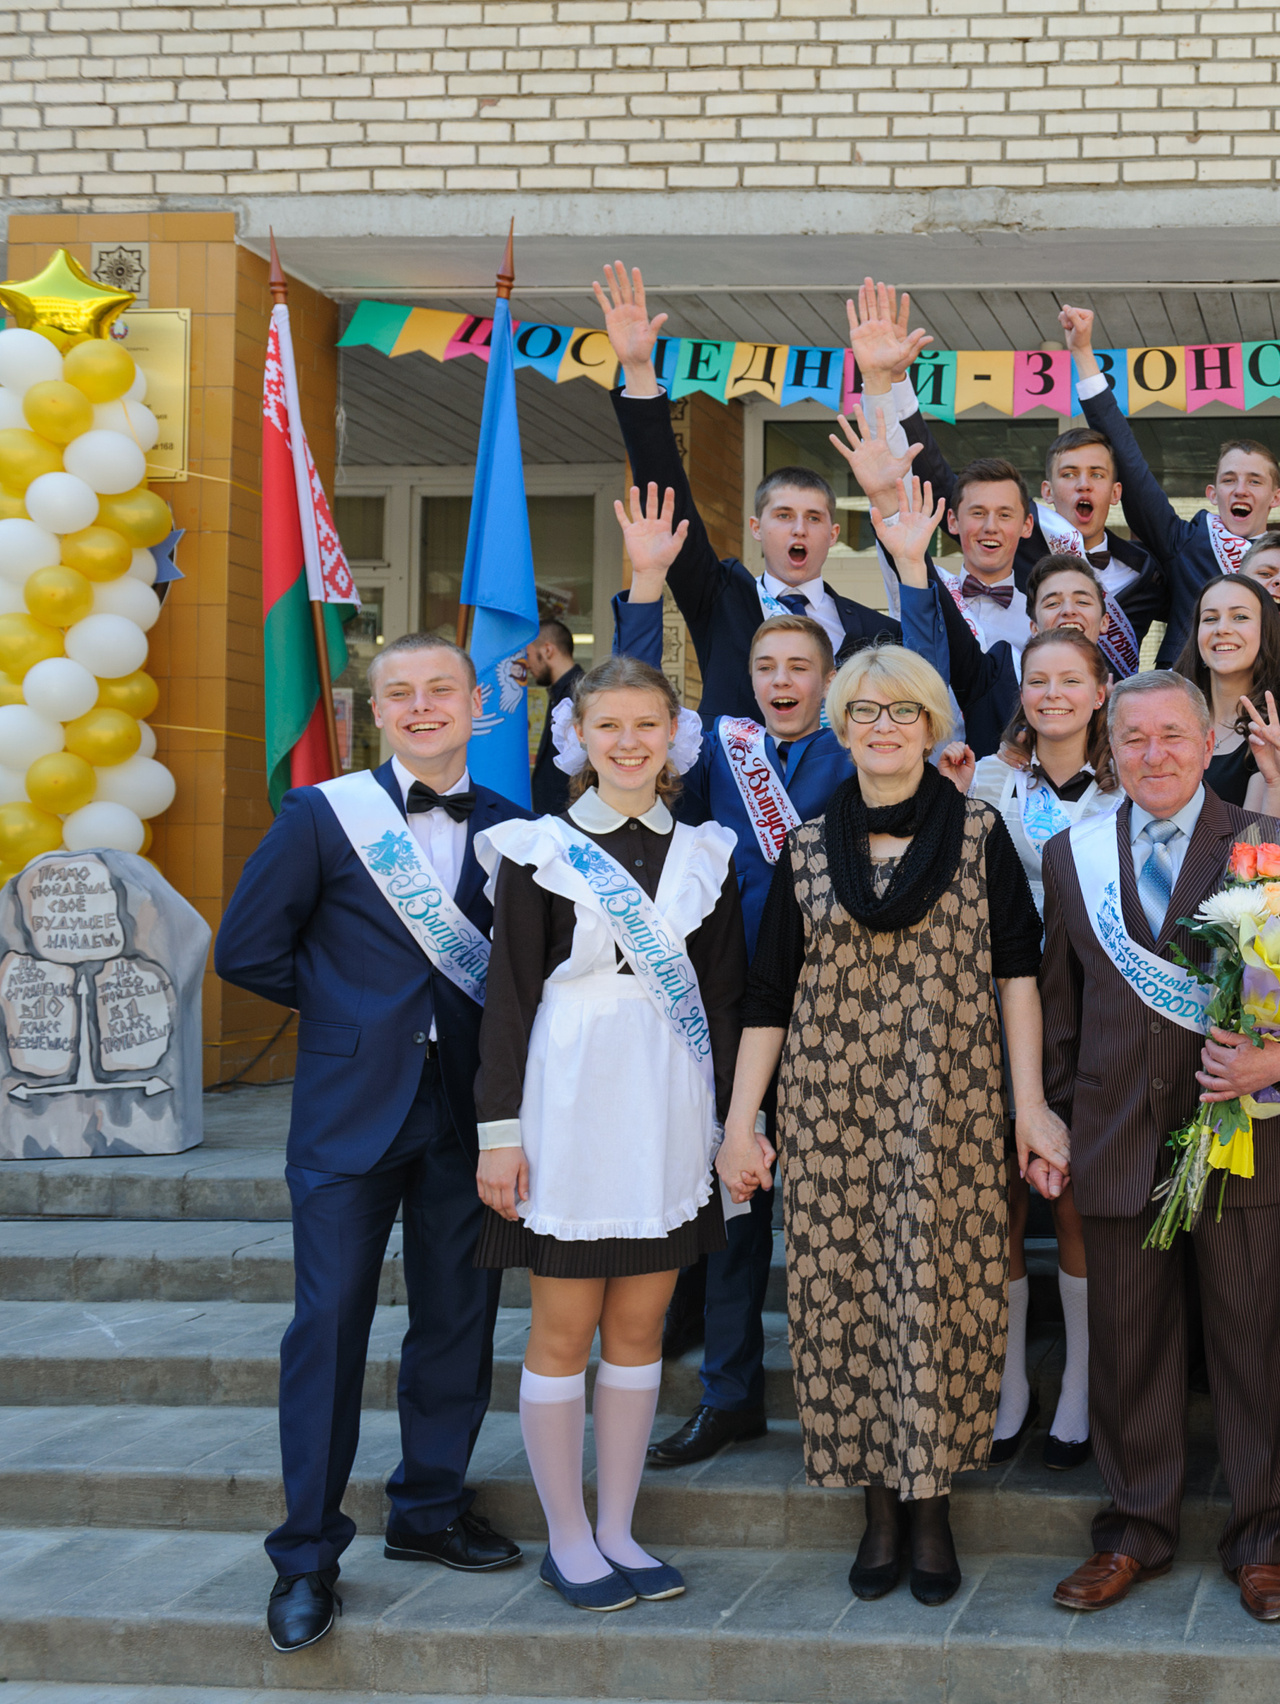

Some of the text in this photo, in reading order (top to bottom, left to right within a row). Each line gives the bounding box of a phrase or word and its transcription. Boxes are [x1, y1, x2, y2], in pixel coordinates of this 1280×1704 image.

[31, 913, 116, 932] БУДУЩЕЕ
[587, 873, 697, 1021] Выпускник
[1114, 925, 1197, 995] Классный
